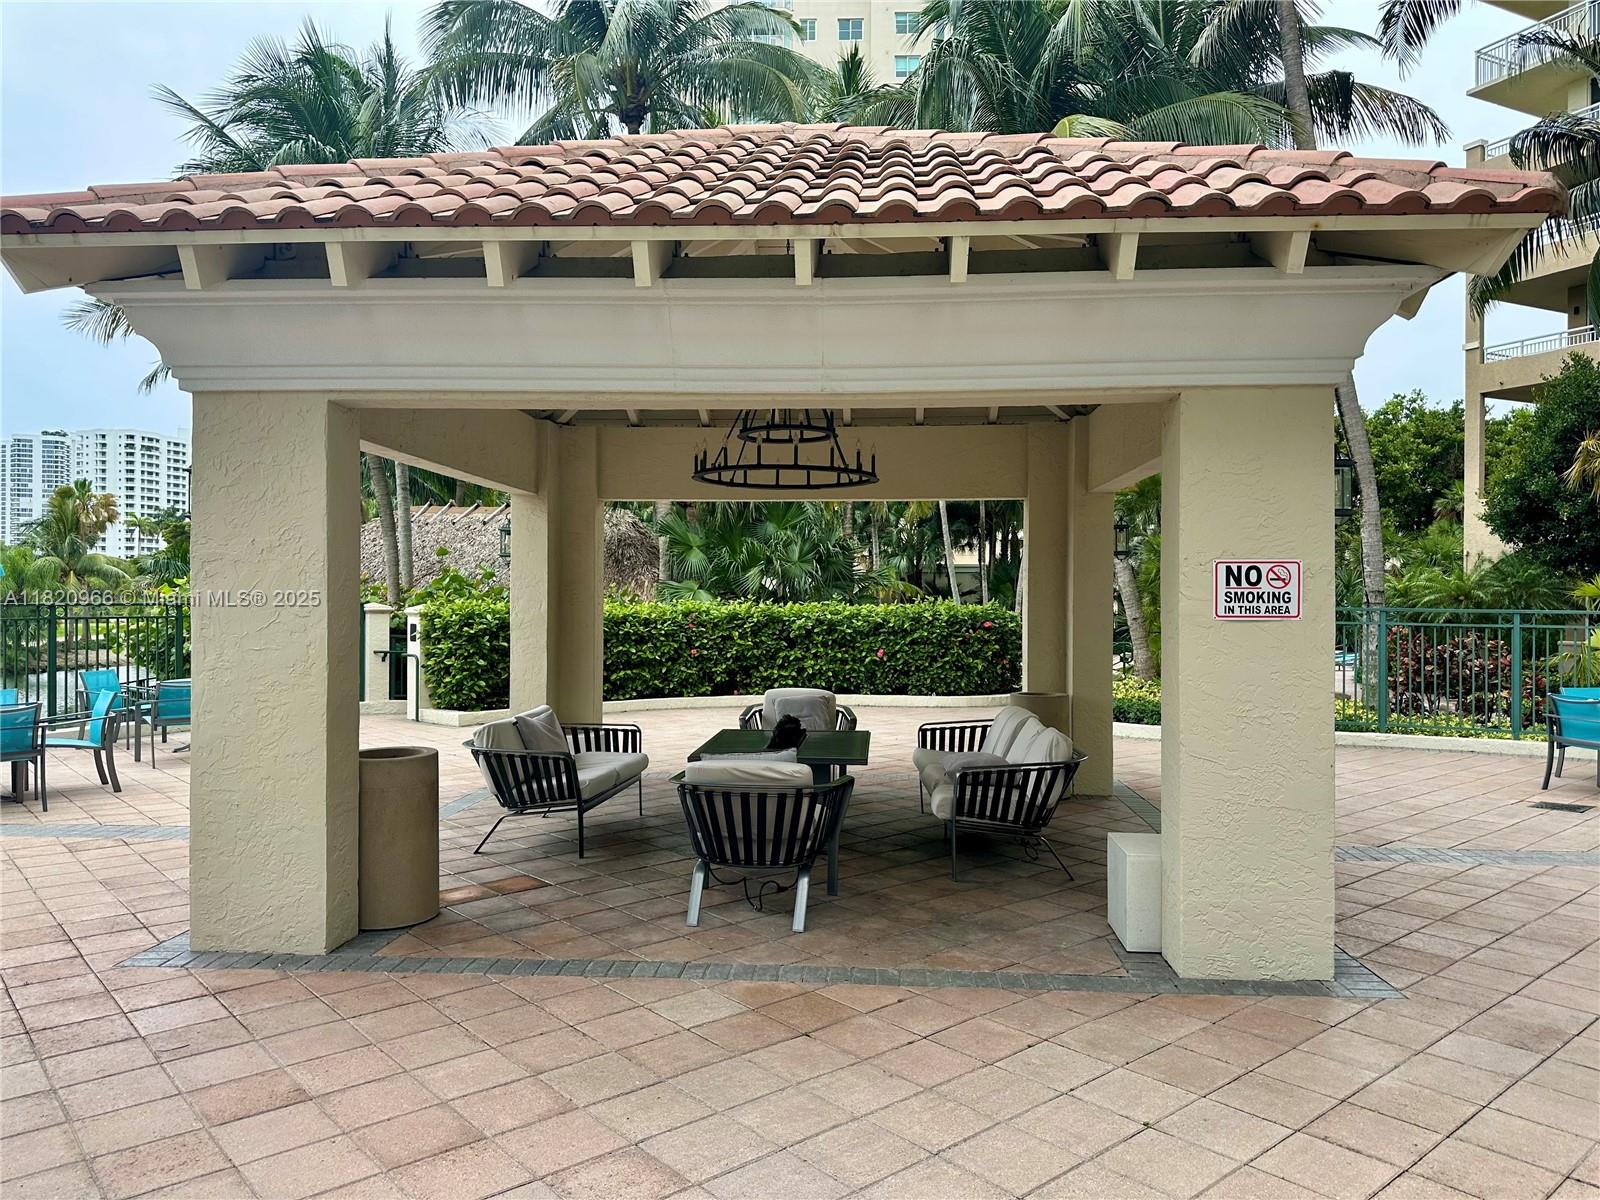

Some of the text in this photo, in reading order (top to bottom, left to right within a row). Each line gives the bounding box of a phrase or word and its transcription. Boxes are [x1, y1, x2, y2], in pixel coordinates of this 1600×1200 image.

[1225, 565, 1262, 586] NO
[1224, 591, 1291, 603] SMOKING
[1224, 605, 1291, 615] IN THIS AREA
